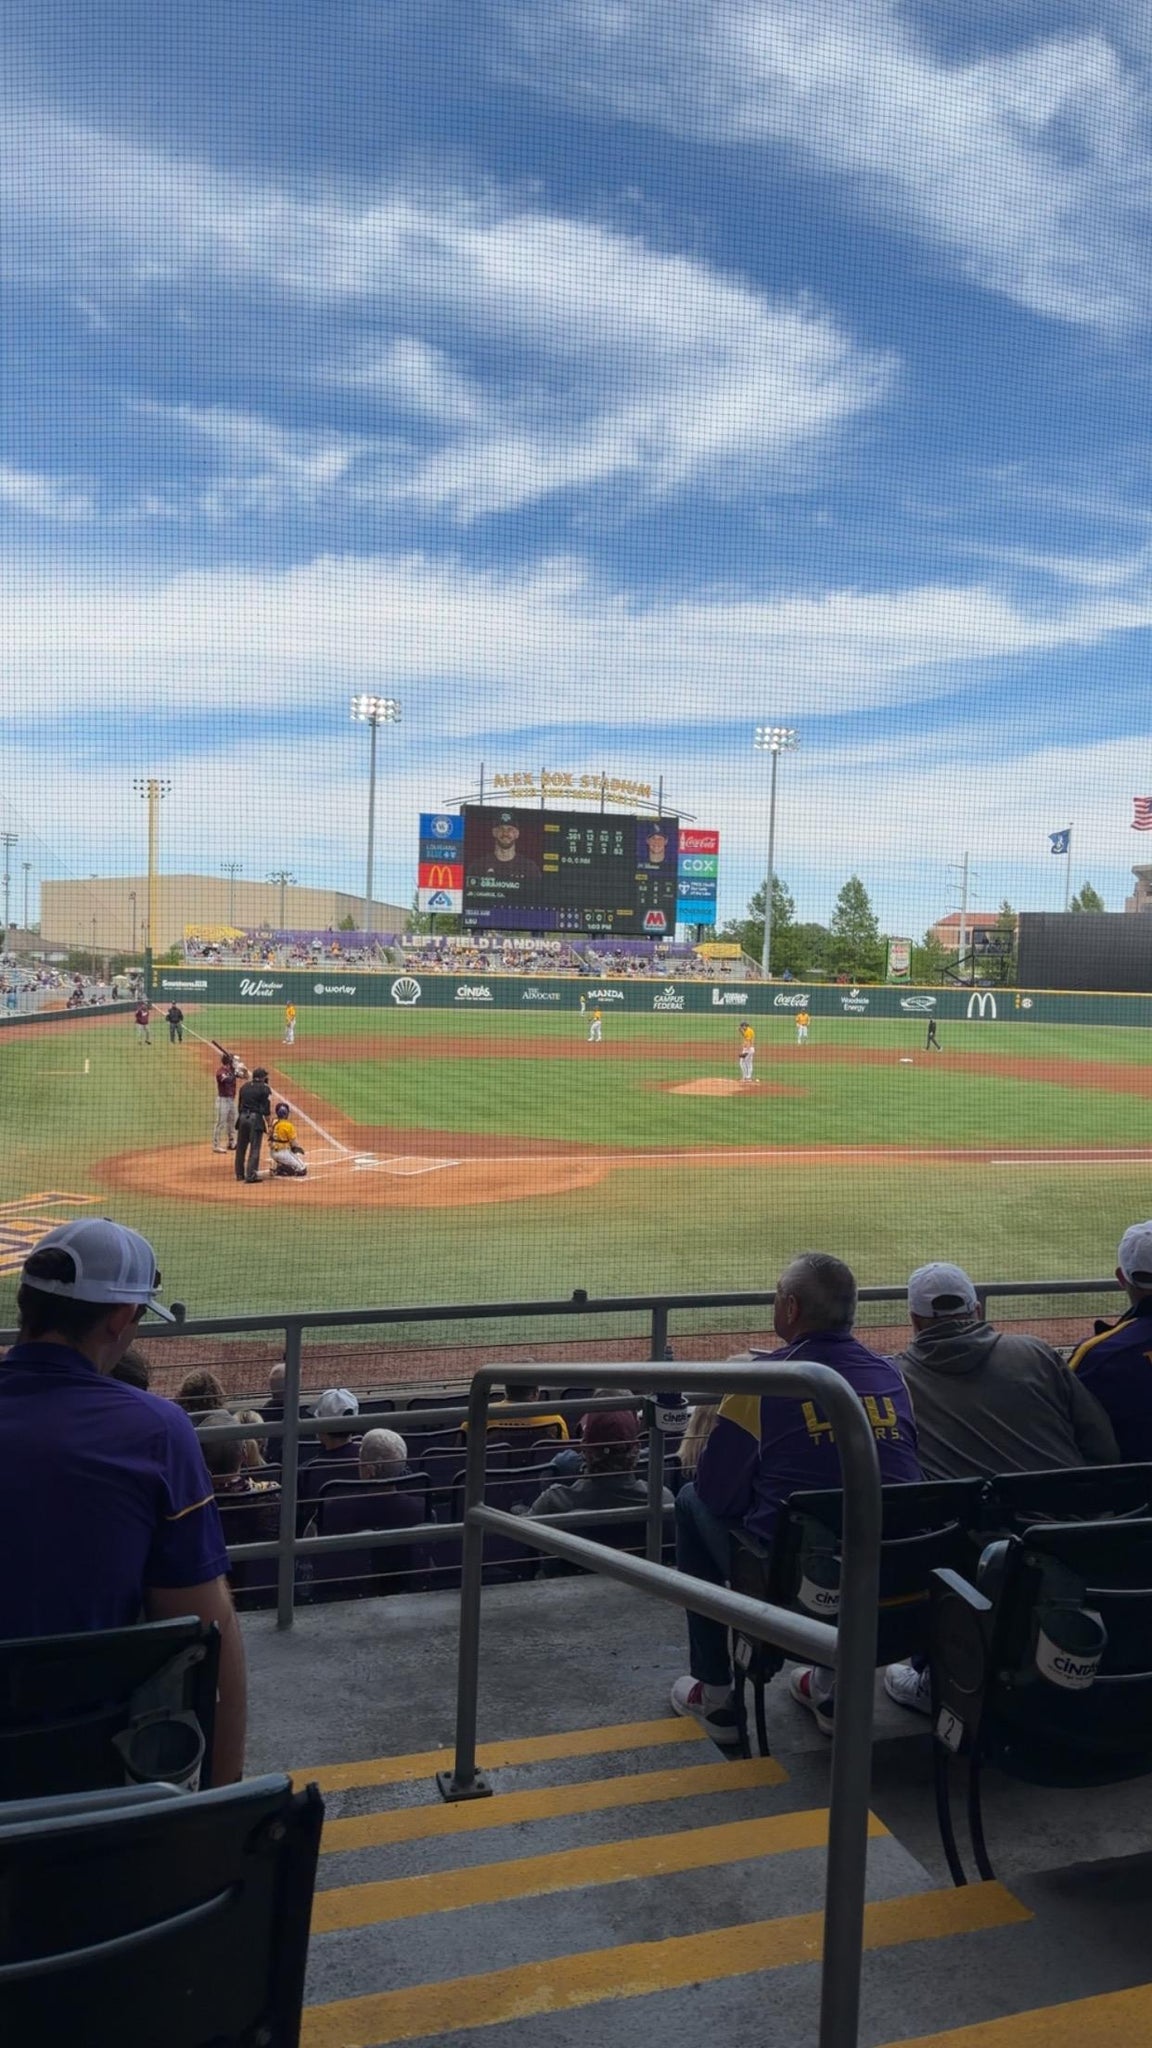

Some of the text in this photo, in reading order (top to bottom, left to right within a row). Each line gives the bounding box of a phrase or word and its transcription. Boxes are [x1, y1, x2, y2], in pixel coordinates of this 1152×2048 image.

[682, 859, 713, 872] COX
[402, 935, 561, 951] LEFT FIELD LANDING
[325, 985, 357, 996] worley
[457, 984, 491, 996] CINTAS
[522, 991, 561, 1000] ADVOCATE
[588, 989, 624, 999] MANDA
[653, 995, 685, 1003] CAMPUS
[653, 1002, 684, 1010] FEDERAL
[844, 1004, 866, 1013] Energy
[801, 1395, 897, 1432] LU
[809, 1427, 900, 1446] TIRS
[944, 1716, 955, 1741] 2
